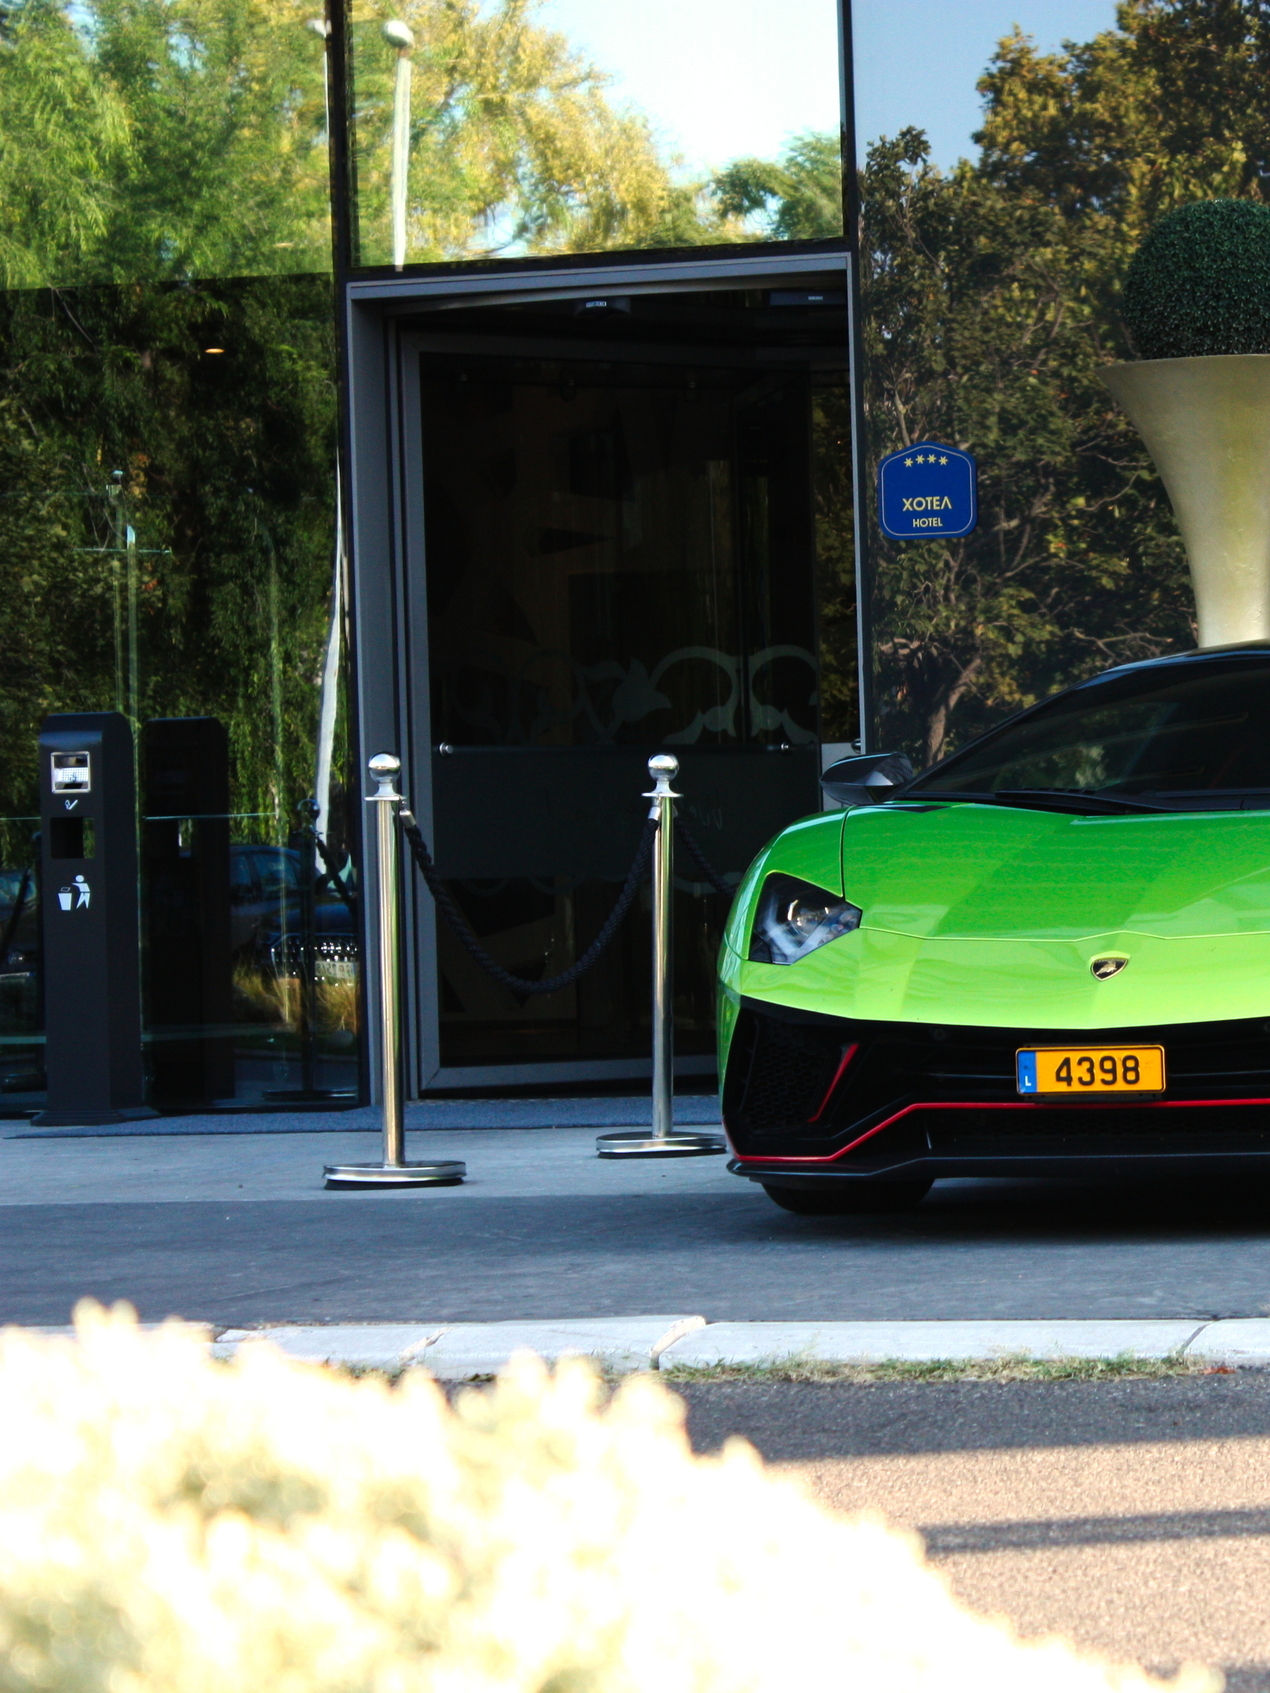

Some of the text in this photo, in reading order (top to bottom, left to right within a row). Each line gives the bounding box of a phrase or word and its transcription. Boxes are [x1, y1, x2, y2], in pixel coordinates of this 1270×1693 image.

[902, 496, 952, 511] ХОТЕЛ
[912, 517, 943, 527] HOTEL
[1055, 1055, 1140, 1086] 4398
[1024, 1075, 1032, 1086] L
